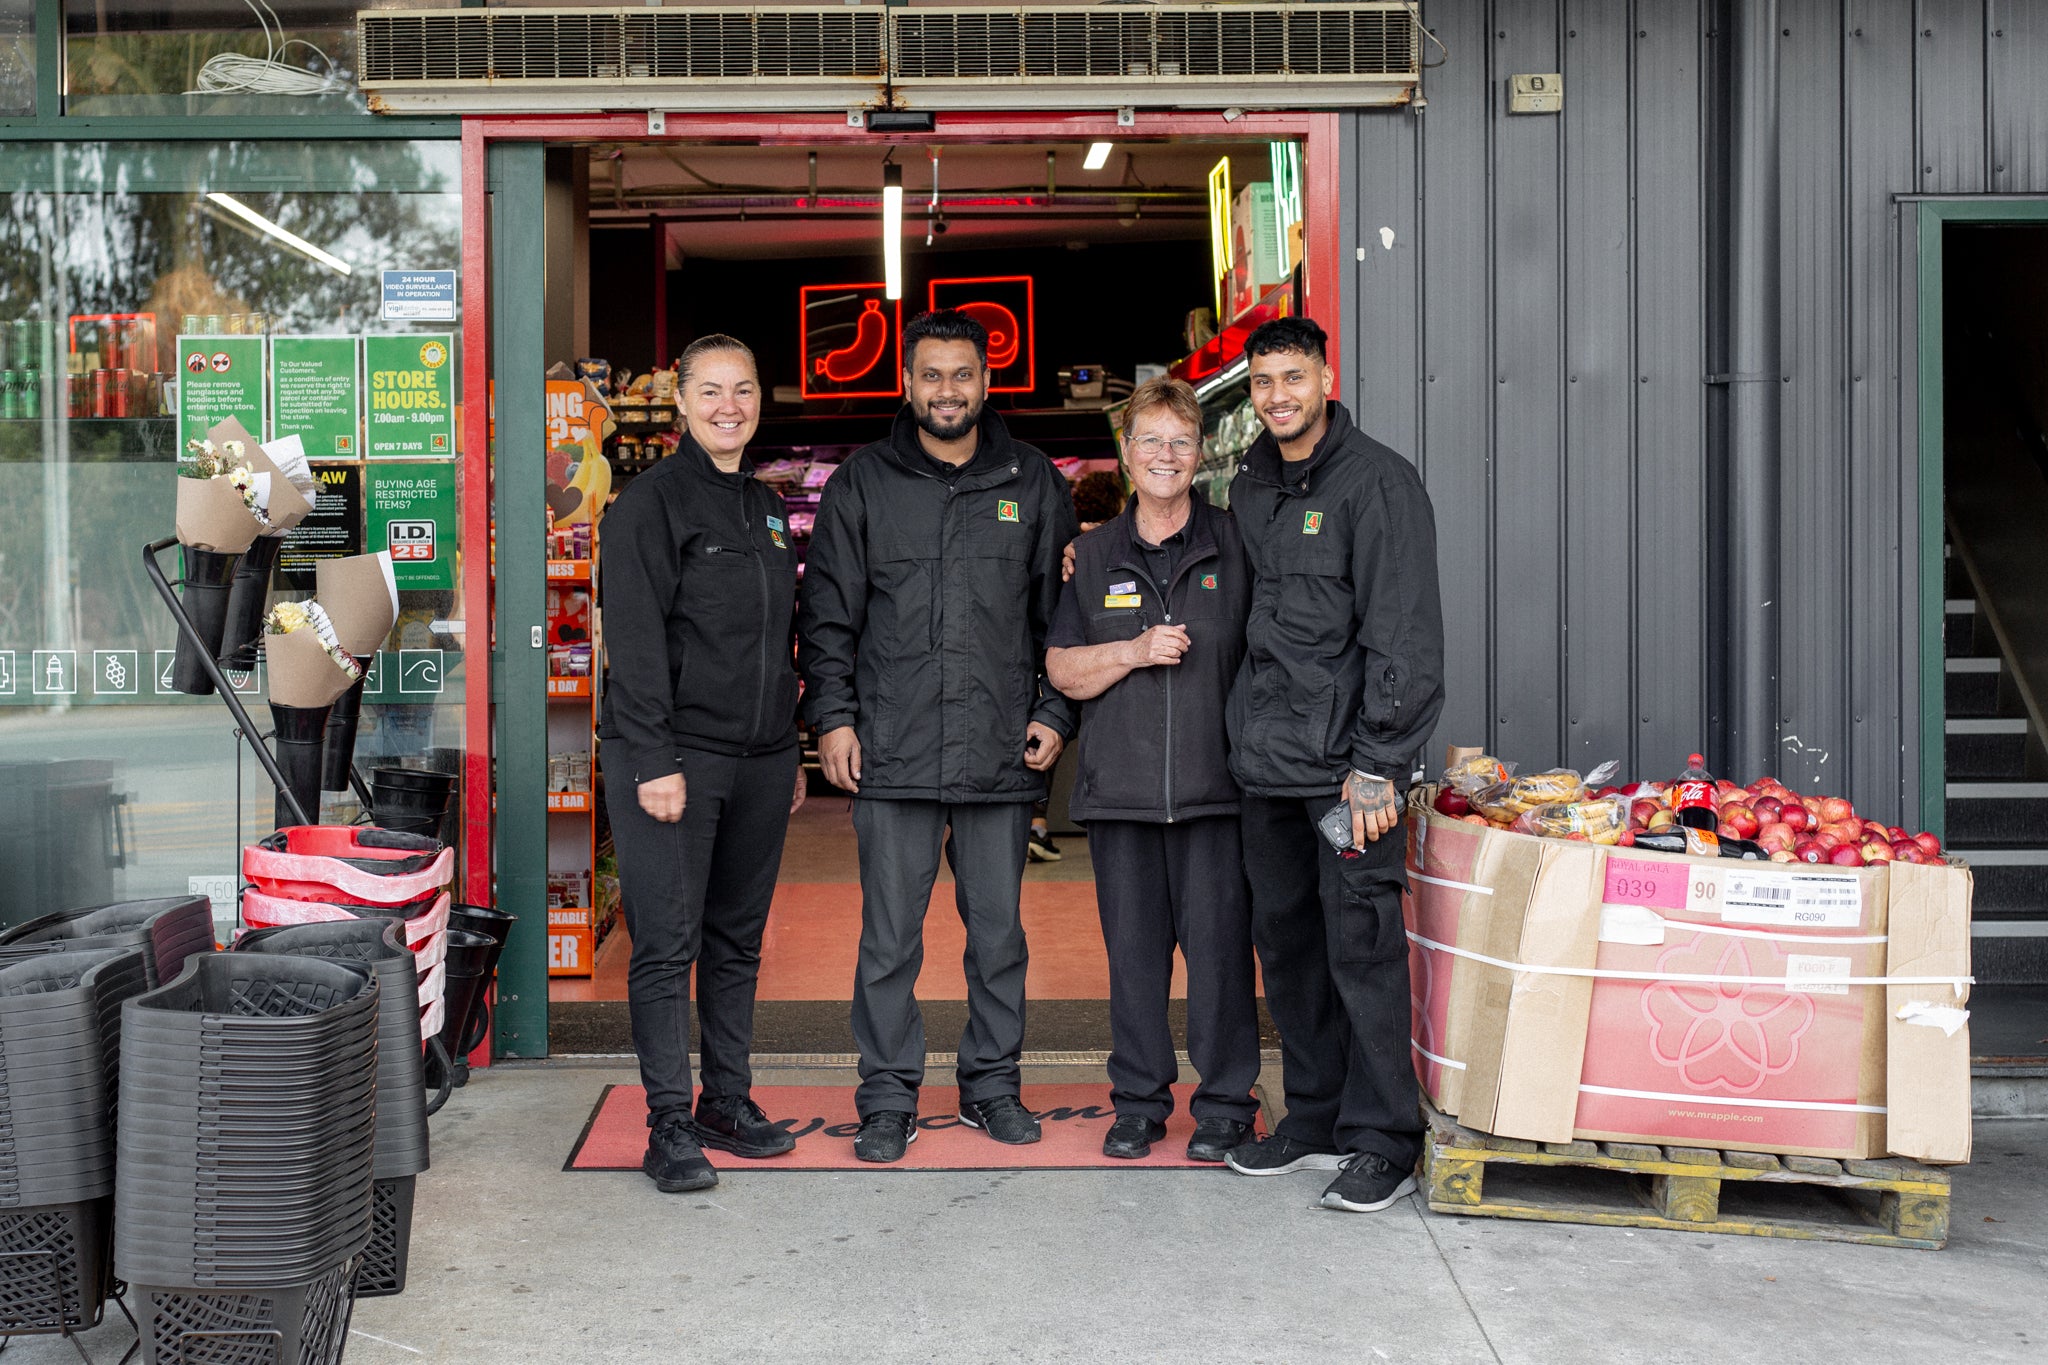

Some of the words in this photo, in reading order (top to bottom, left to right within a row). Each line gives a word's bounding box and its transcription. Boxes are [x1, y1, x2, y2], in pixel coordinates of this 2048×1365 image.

[373, 370, 436, 389] STORE
[373, 390, 446, 409] HOURS.
[374, 413, 405, 423] 7.00am
[412, 413, 444, 424] 9.00pm
[312, 471, 347, 484] LAW
[375, 480, 414, 489] BUYING
[416, 480, 436, 488] AGE
[375, 490, 437, 499] RESTRICTED
[375, 500, 411, 509] ITEMS?
[394, 526, 431, 539] I.D.
[395, 546, 428, 558] 25
[558, 681, 578, 692] DAY
[562, 795, 584, 808] BAR
[1611, 860, 1640, 872] ROYAL
[1643, 863, 1670, 874] GALA
[1617, 878, 1656, 899] 039
[1695, 881, 1716, 900] 90
[1795, 912, 1826, 922] RG090
[1668, 1109, 1764, 1123] www.mrapple.com
